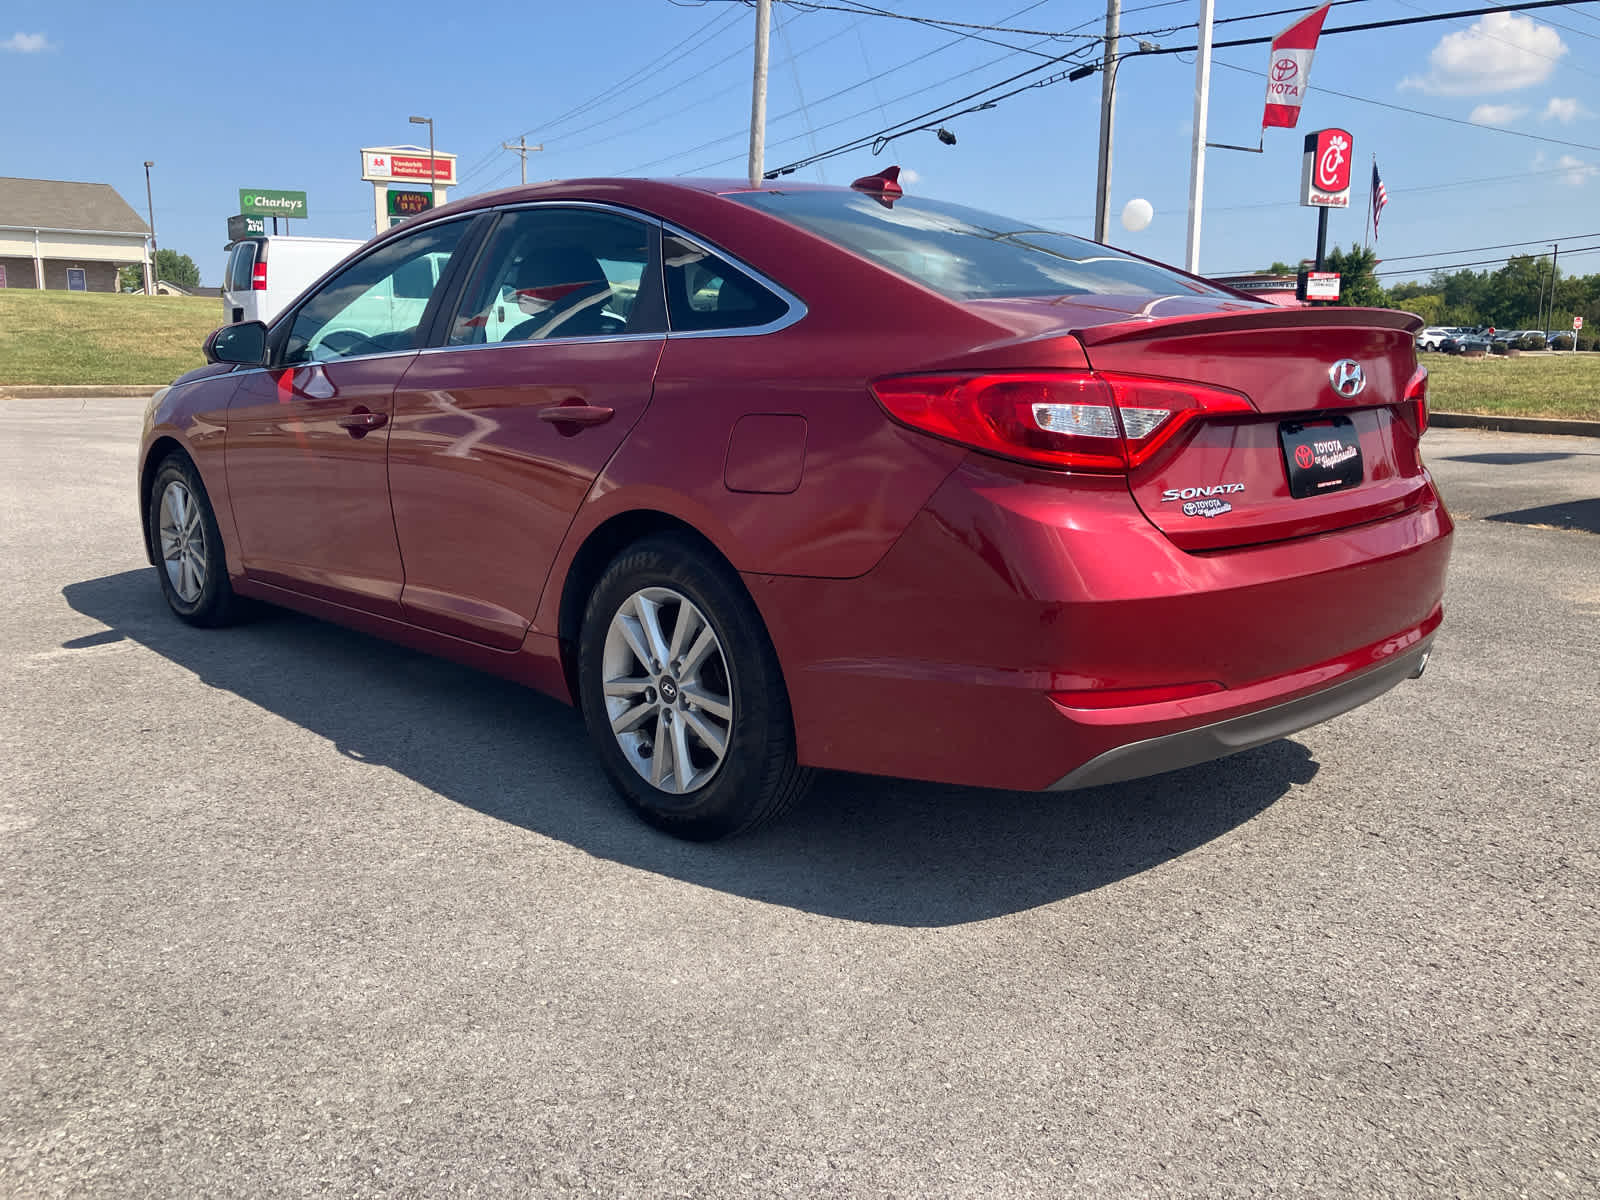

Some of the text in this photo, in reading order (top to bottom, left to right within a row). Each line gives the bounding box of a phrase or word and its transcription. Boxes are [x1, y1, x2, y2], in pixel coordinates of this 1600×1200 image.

[1270, 83, 1299, 96] YOTA
[1313, 440, 1343, 455] TOYOTA
[1161, 482, 1246, 502] SONATA
[1195, 499, 1222, 509] TOYOTA
